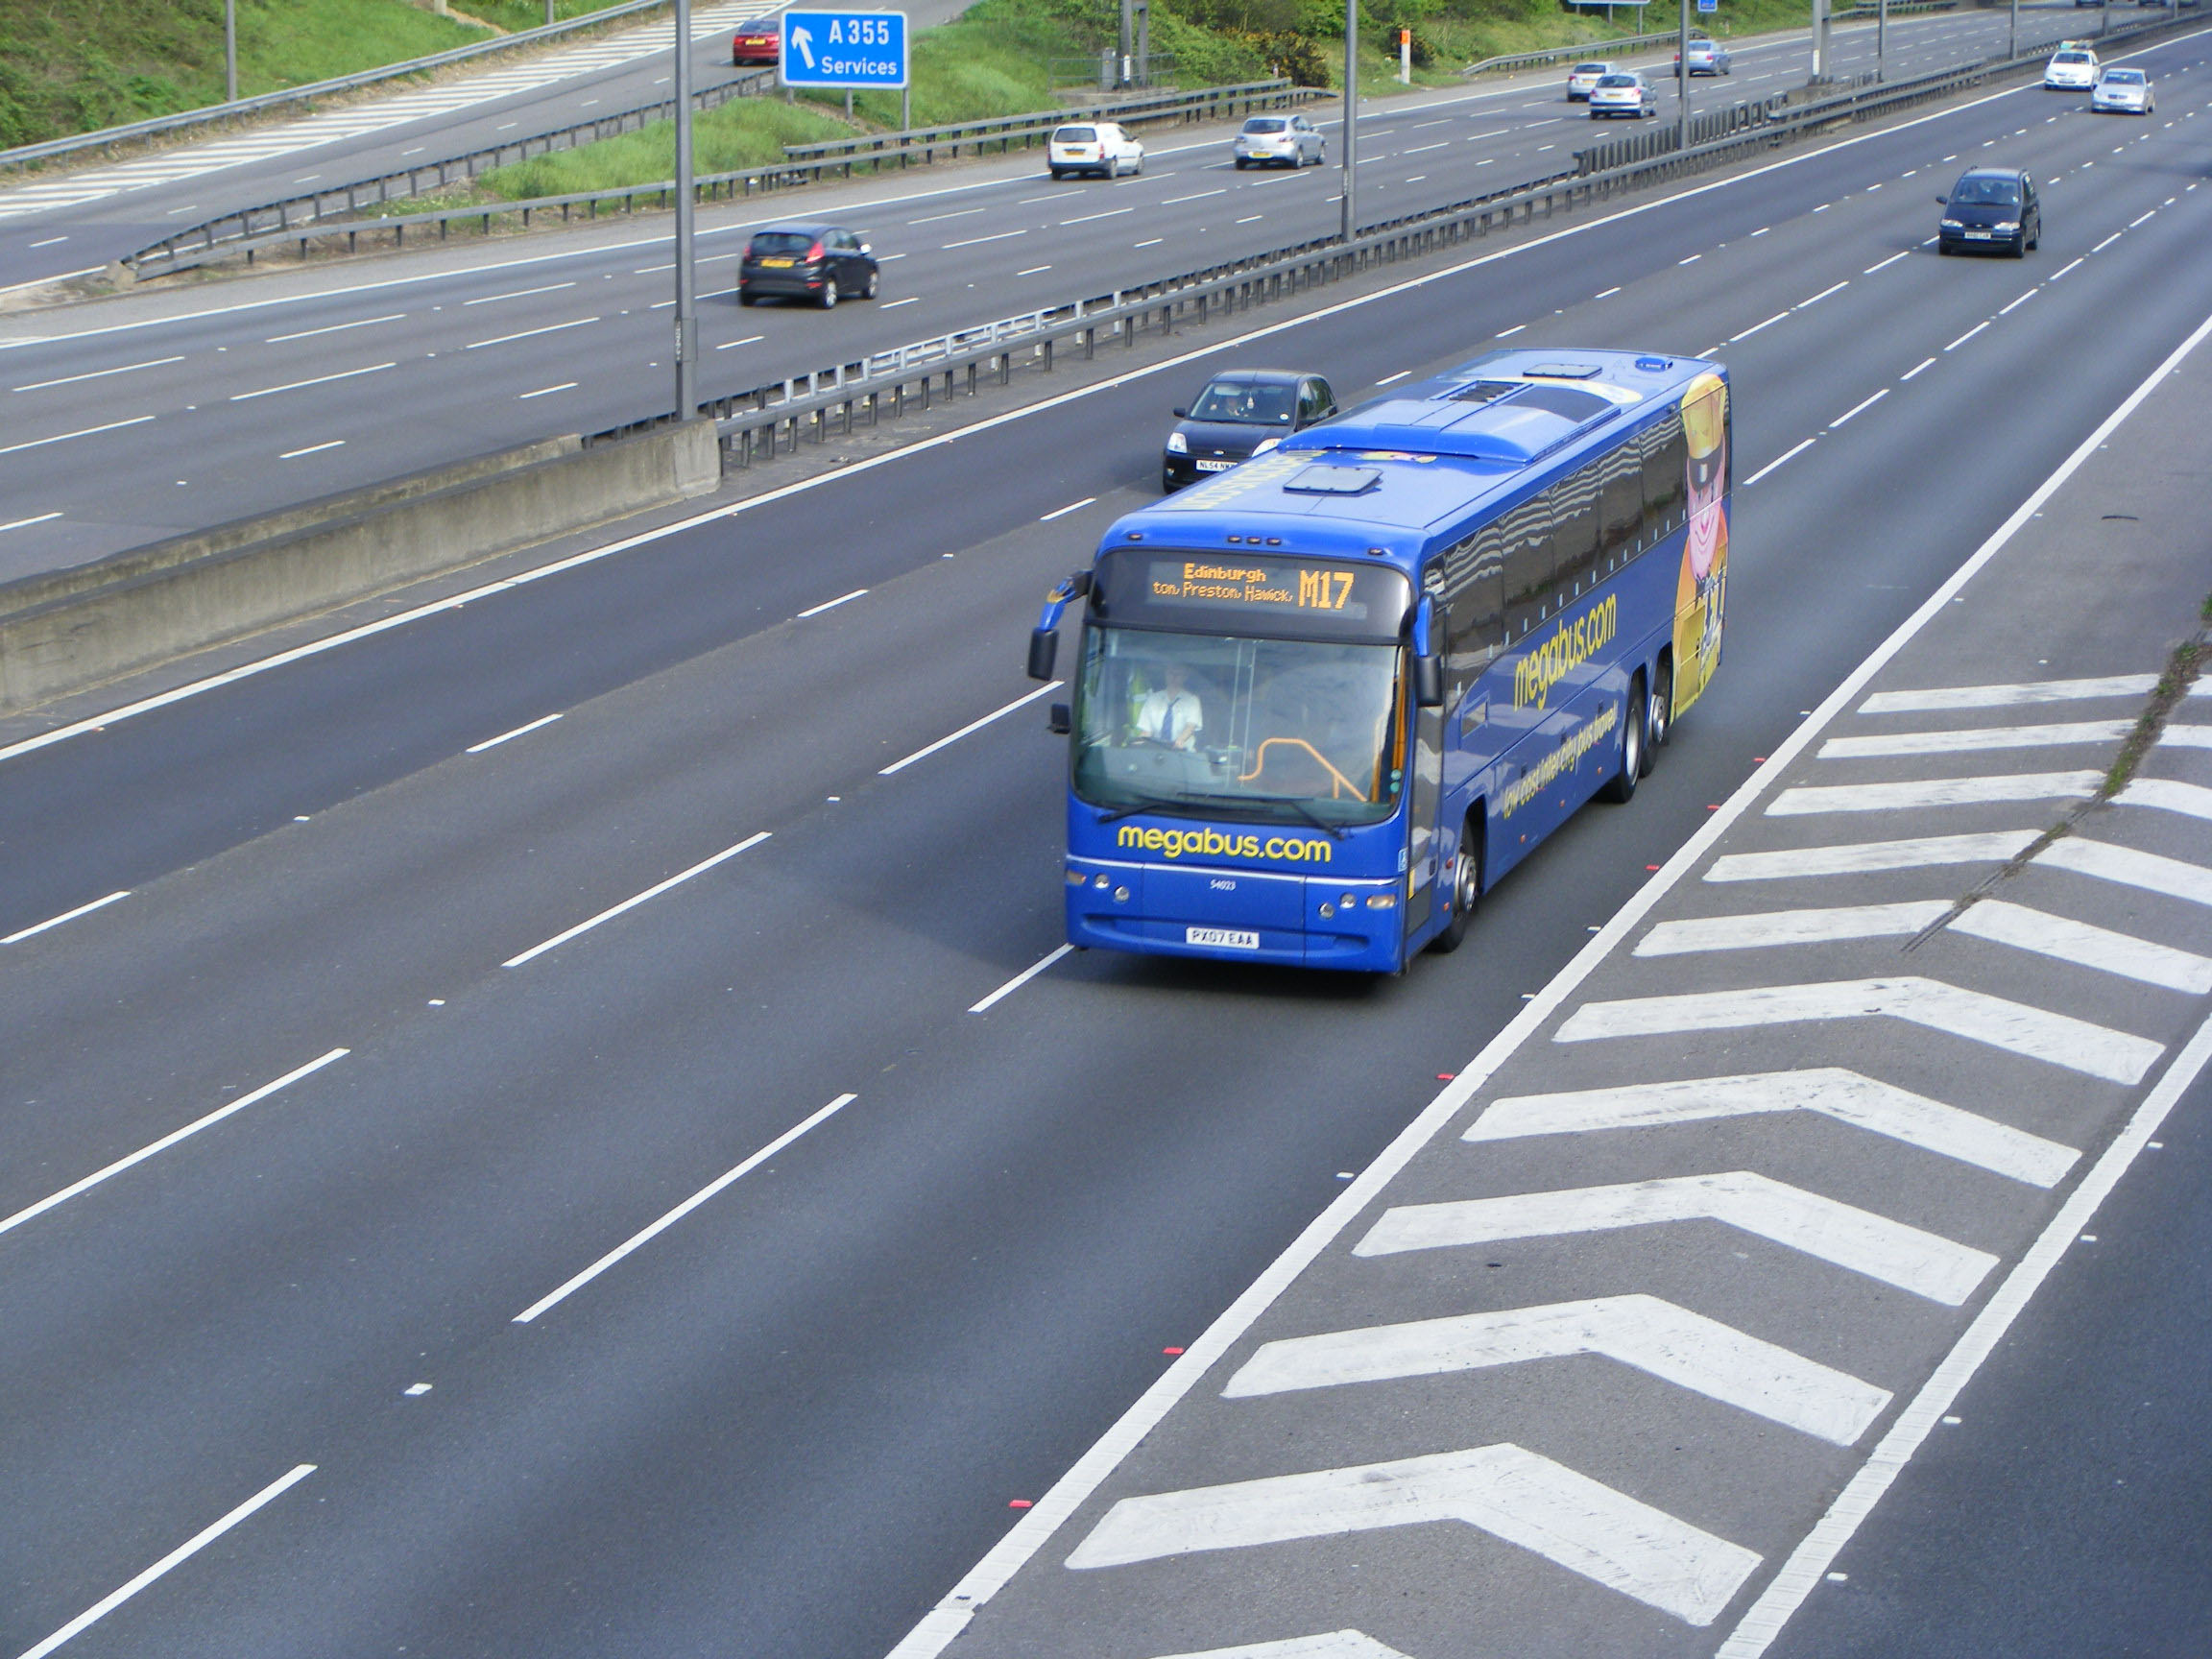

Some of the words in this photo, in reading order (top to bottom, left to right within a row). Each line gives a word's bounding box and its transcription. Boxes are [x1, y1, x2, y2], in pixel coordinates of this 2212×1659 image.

[821, 56, 898, 75] Services
[1183, 563, 1267, 583] Edinburgh
[1182, 581, 1242, 599] Preston,
[1298, 569, 1355, 610] M17
[1514, 592, 1617, 711] megabus.com
[1118, 826, 1332, 862] megabus.com
[1191, 929, 1225, 943] PX07
[1229, 932, 1253, 946] EAA
